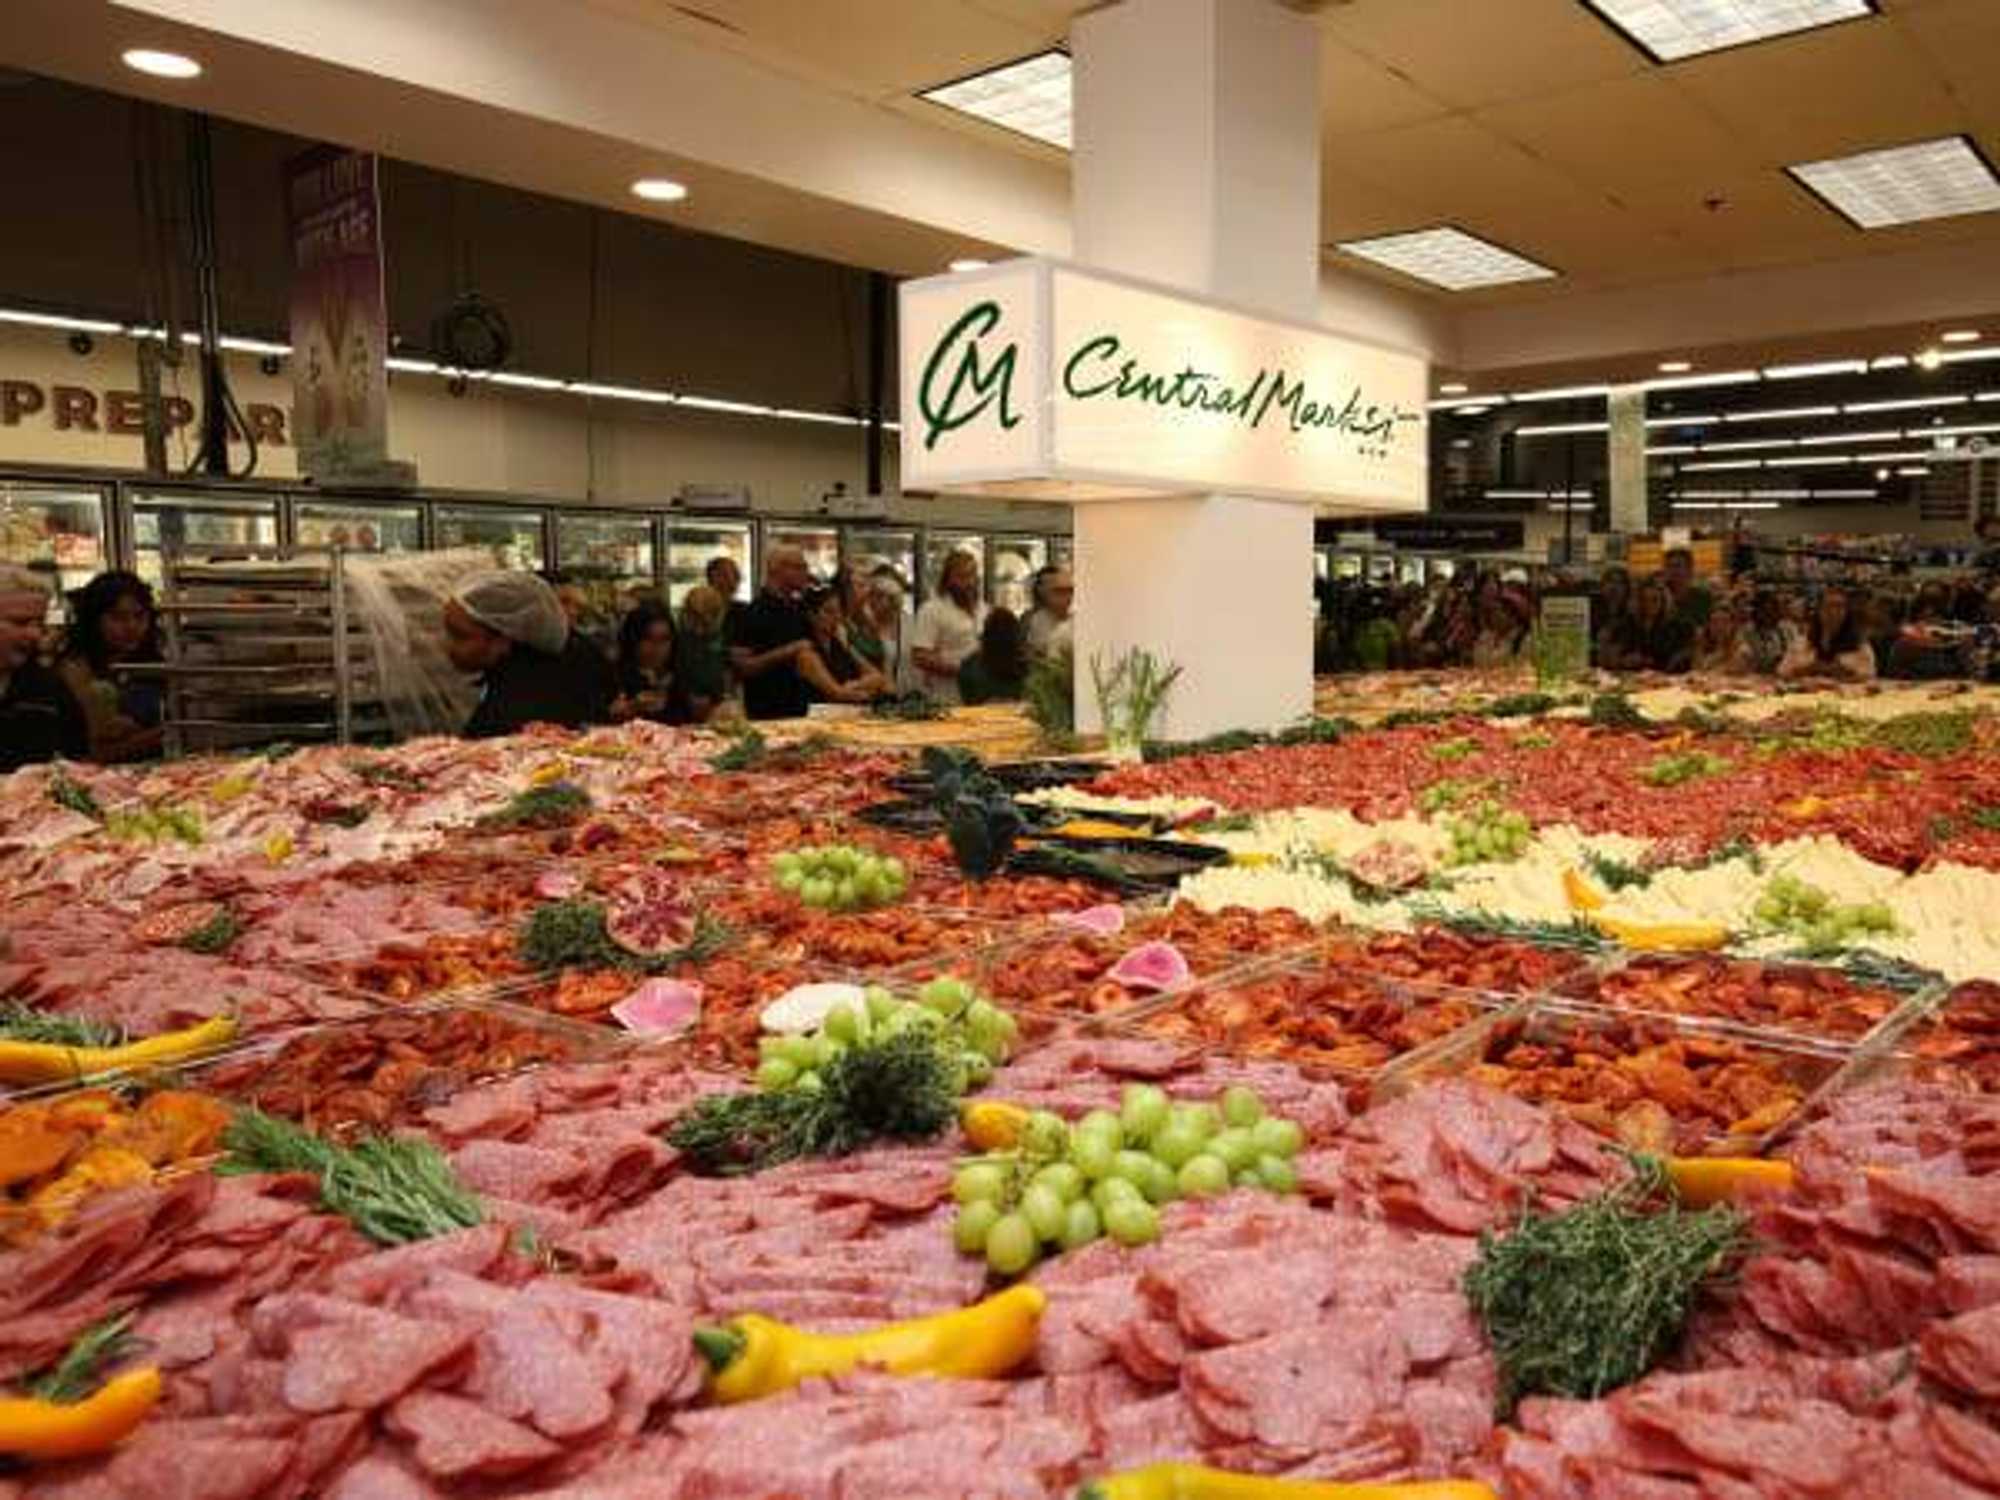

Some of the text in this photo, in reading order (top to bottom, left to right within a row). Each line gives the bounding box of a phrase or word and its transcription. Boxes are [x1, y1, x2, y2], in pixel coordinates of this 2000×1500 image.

[0, 379, 289, 446] PREPR
[919, 301, 1023, 450] CM
[1063, 336, 1265, 417] Central
